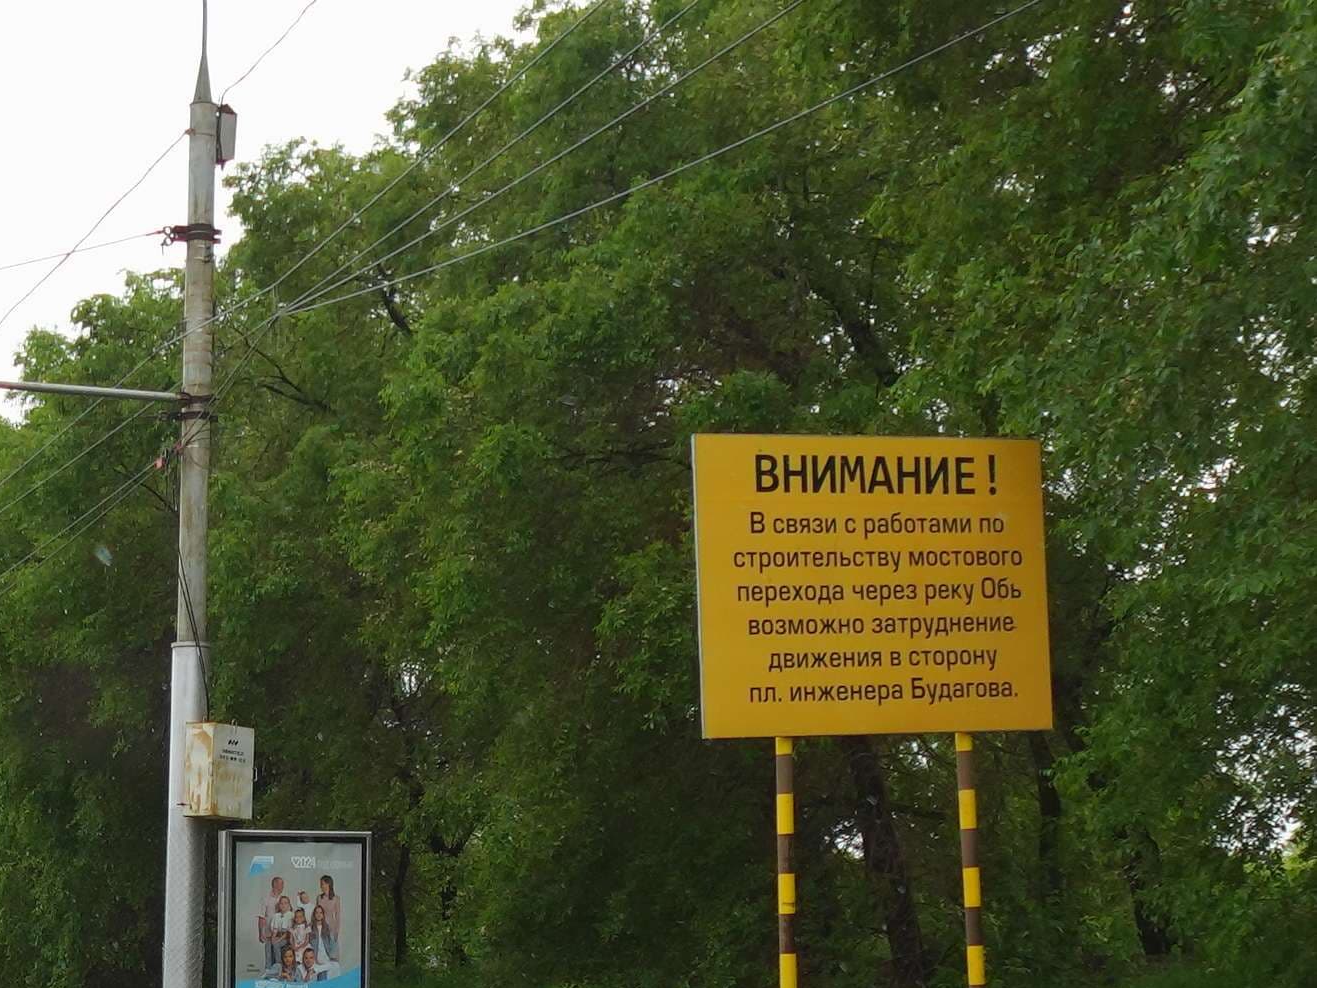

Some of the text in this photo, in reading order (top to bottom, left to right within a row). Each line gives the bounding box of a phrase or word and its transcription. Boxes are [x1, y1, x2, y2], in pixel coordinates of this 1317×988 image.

[750, 511, 1005, 540] В связи с работами по
[733, 549, 1023, 574] строительству мостового
[737, 576, 1022, 608] перехода через реку Обь
[748, 615, 1017, 640] возможно затруднение
[768, 648, 998, 673] движения в сторону
[749, 677, 1019, 706] пл. инженера Будагова.
